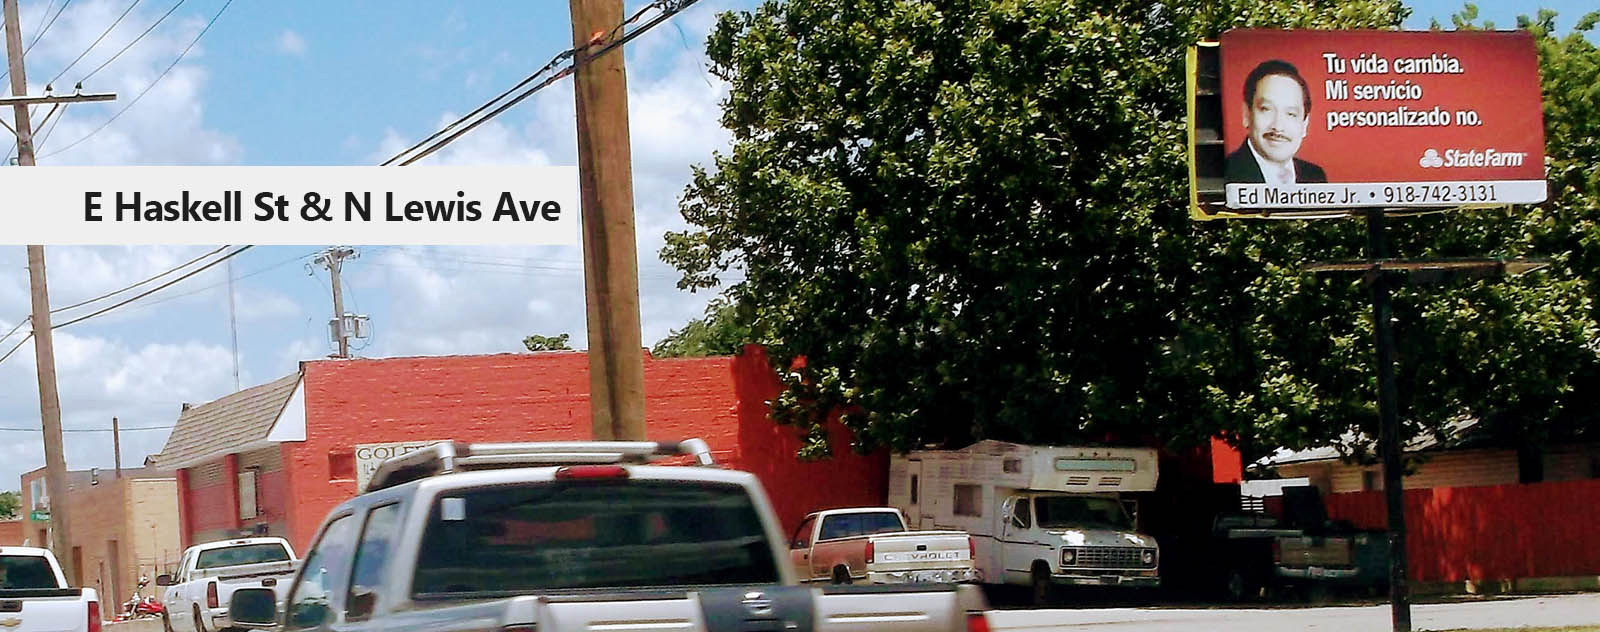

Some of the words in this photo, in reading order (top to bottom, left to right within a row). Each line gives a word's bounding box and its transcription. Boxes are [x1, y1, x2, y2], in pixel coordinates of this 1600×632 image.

[1323, 53, 1346, 74] Tu
[1351, 54, 1389, 74] vida
[1325, 80, 1348, 100] Mi
[1353, 80, 1422, 100] servicio
[1327, 106, 1450, 131] personalizado
[1456, 110, 1483, 127] no.
[1239, 187, 1259, 206] Ed
[1264, 187, 1336, 205] Martinez
[1341, 185, 1361, 204] Jr.
[1384, 184, 1497, 203] 918-742-3131
